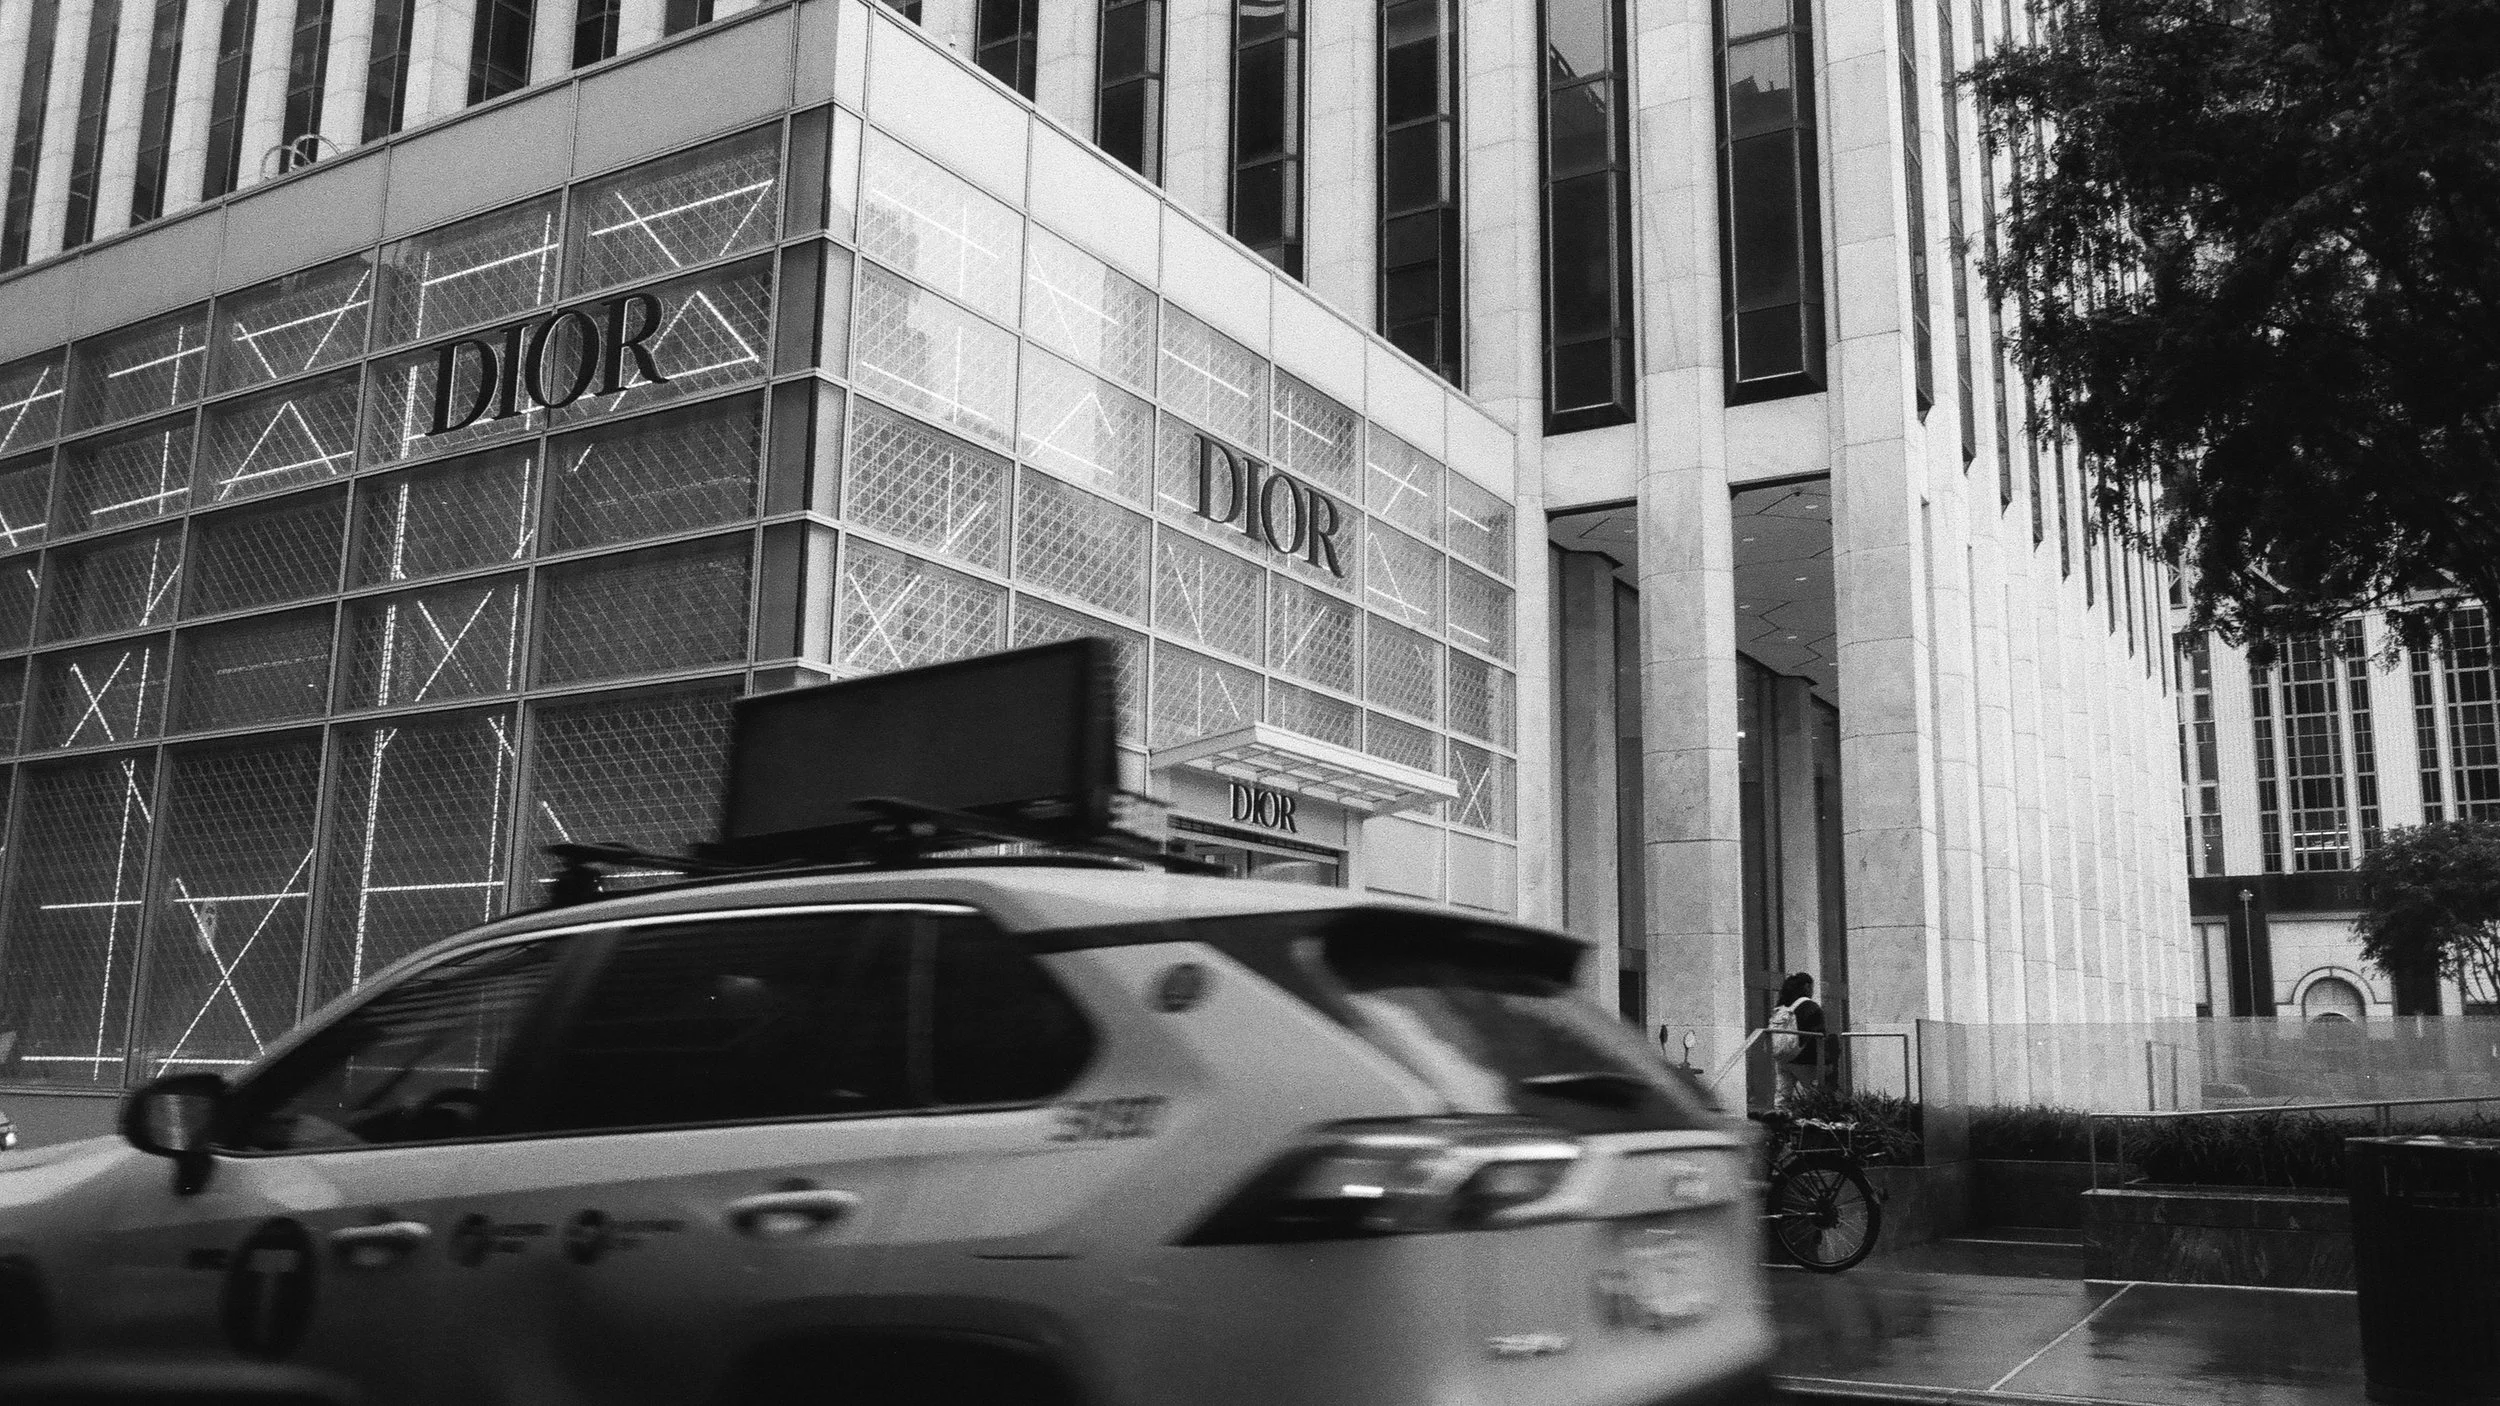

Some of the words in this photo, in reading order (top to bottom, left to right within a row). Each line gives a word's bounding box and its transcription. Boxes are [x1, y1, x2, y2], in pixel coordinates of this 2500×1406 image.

[426, 293, 669, 436] DIOR
[1194, 433, 1344, 579] DIOR
[1230, 783, 1297, 833] DIOR
